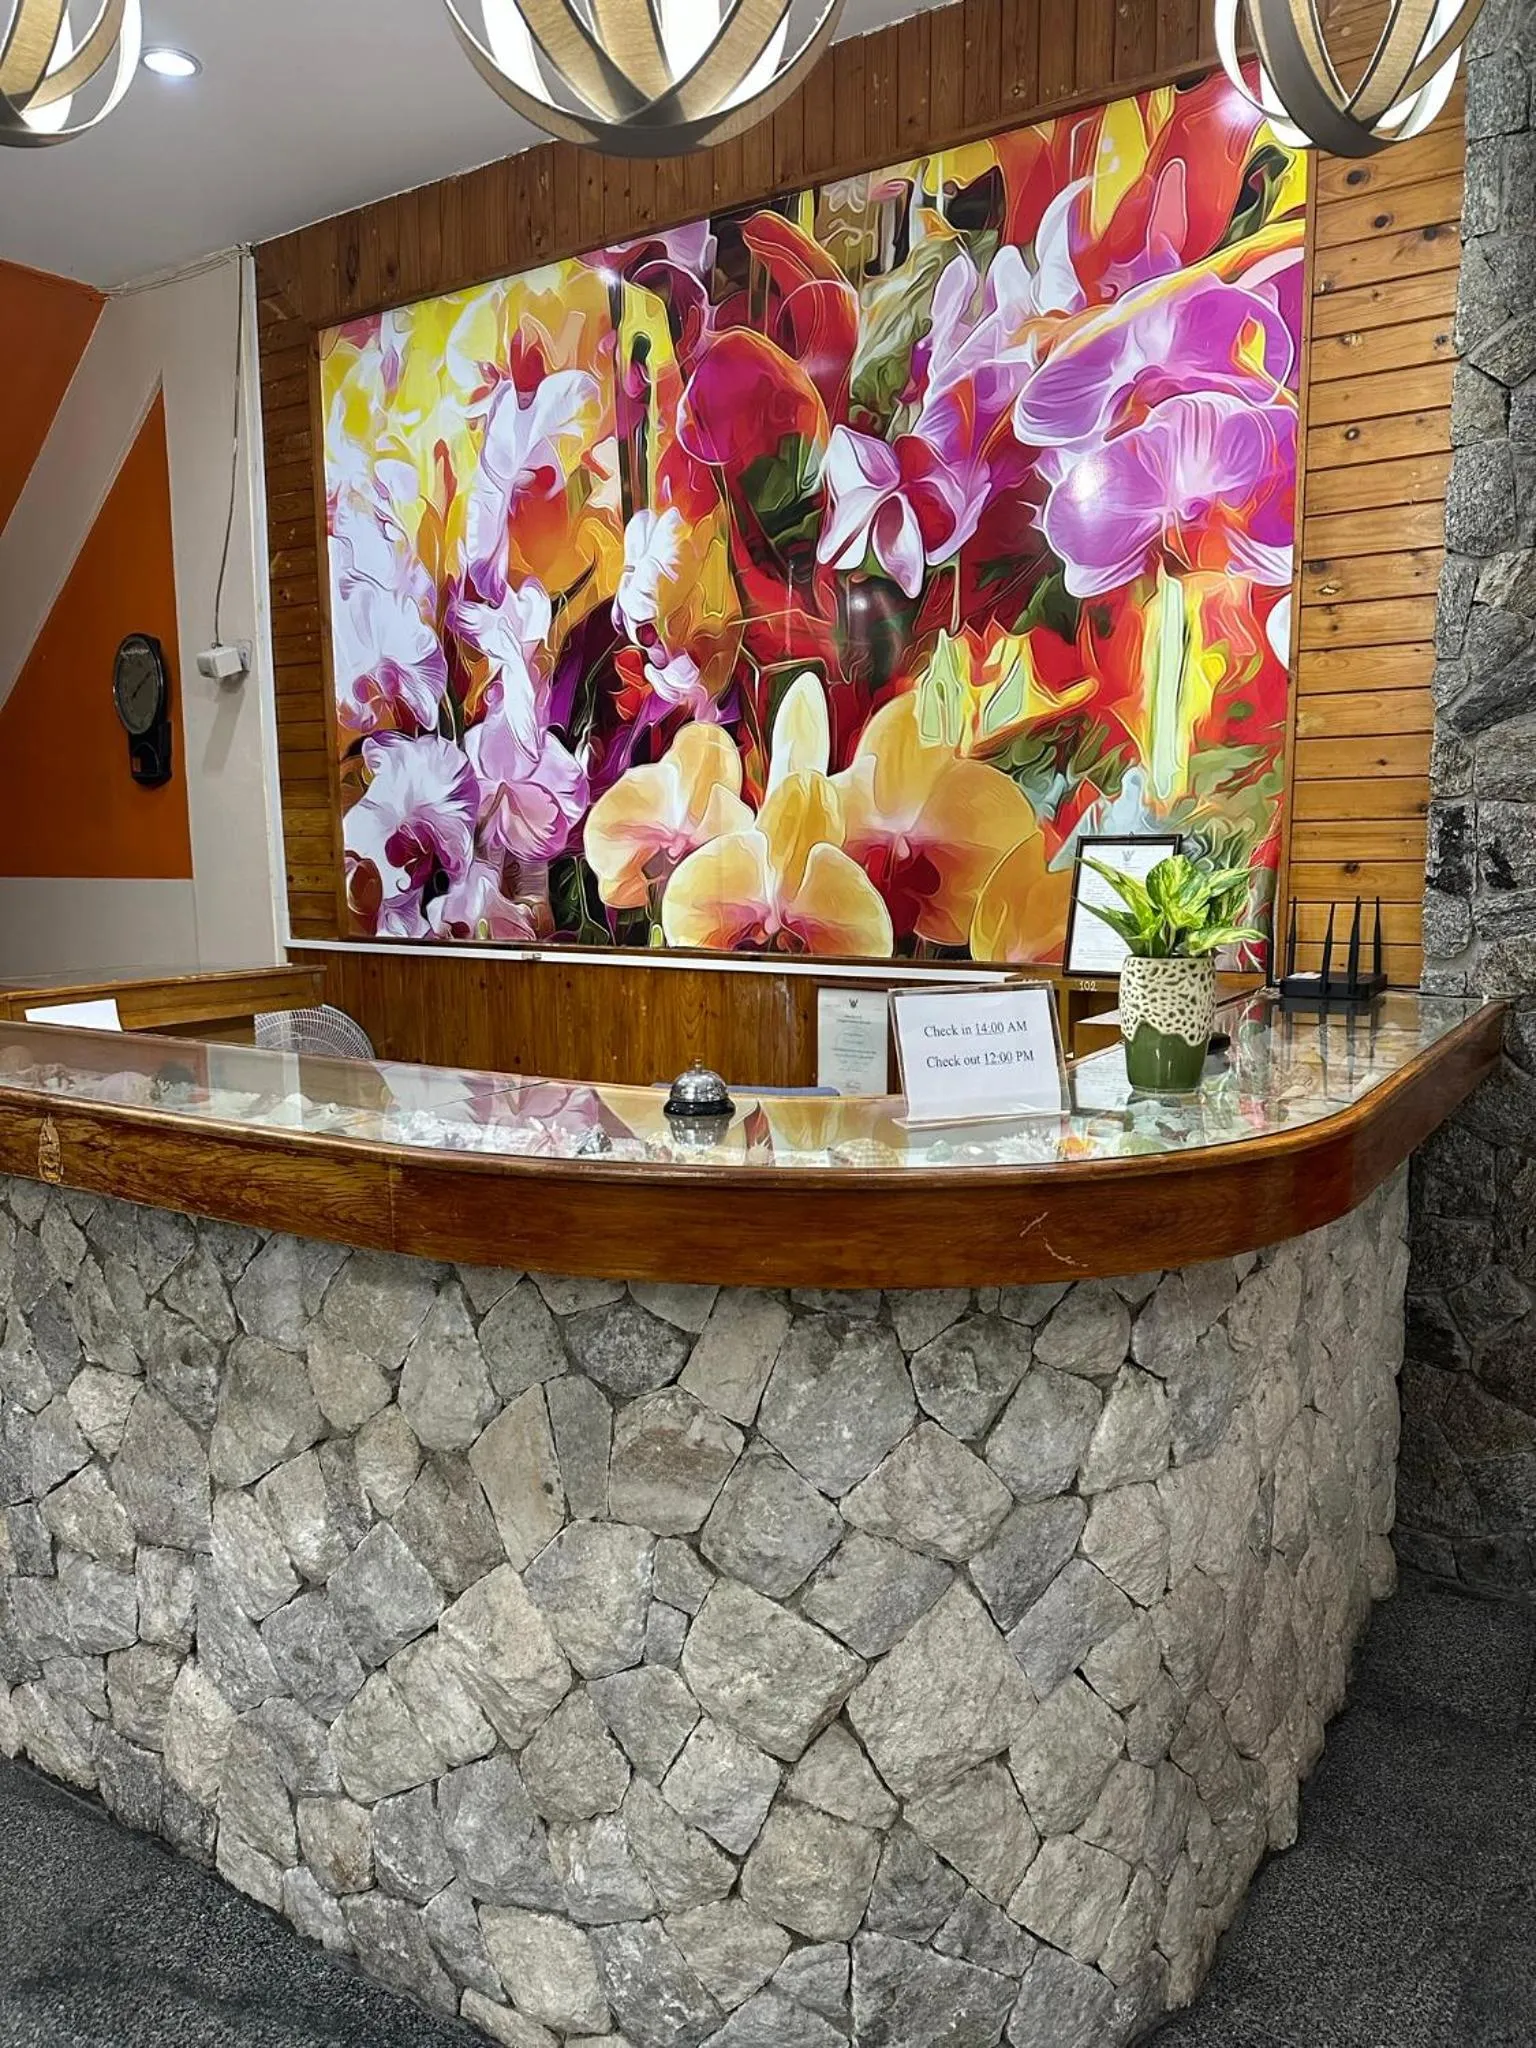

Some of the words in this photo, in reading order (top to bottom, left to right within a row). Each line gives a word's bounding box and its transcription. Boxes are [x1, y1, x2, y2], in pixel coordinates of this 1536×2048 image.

[1079, 980, 1097, 991] 102
[923, 1024, 959, 1038] Check
[961, 1025, 972, 1035] in
[975, 1021, 1005, 1035] 14:00
[1007, 1020, 1028, 1033] AM
[926, 1054, 961, 1068] Check
[963, 1056, 981, 1066] out
[984, 1050, 1013, 1065] 12:00
[1016, 1049, 1034, 1062] PM
